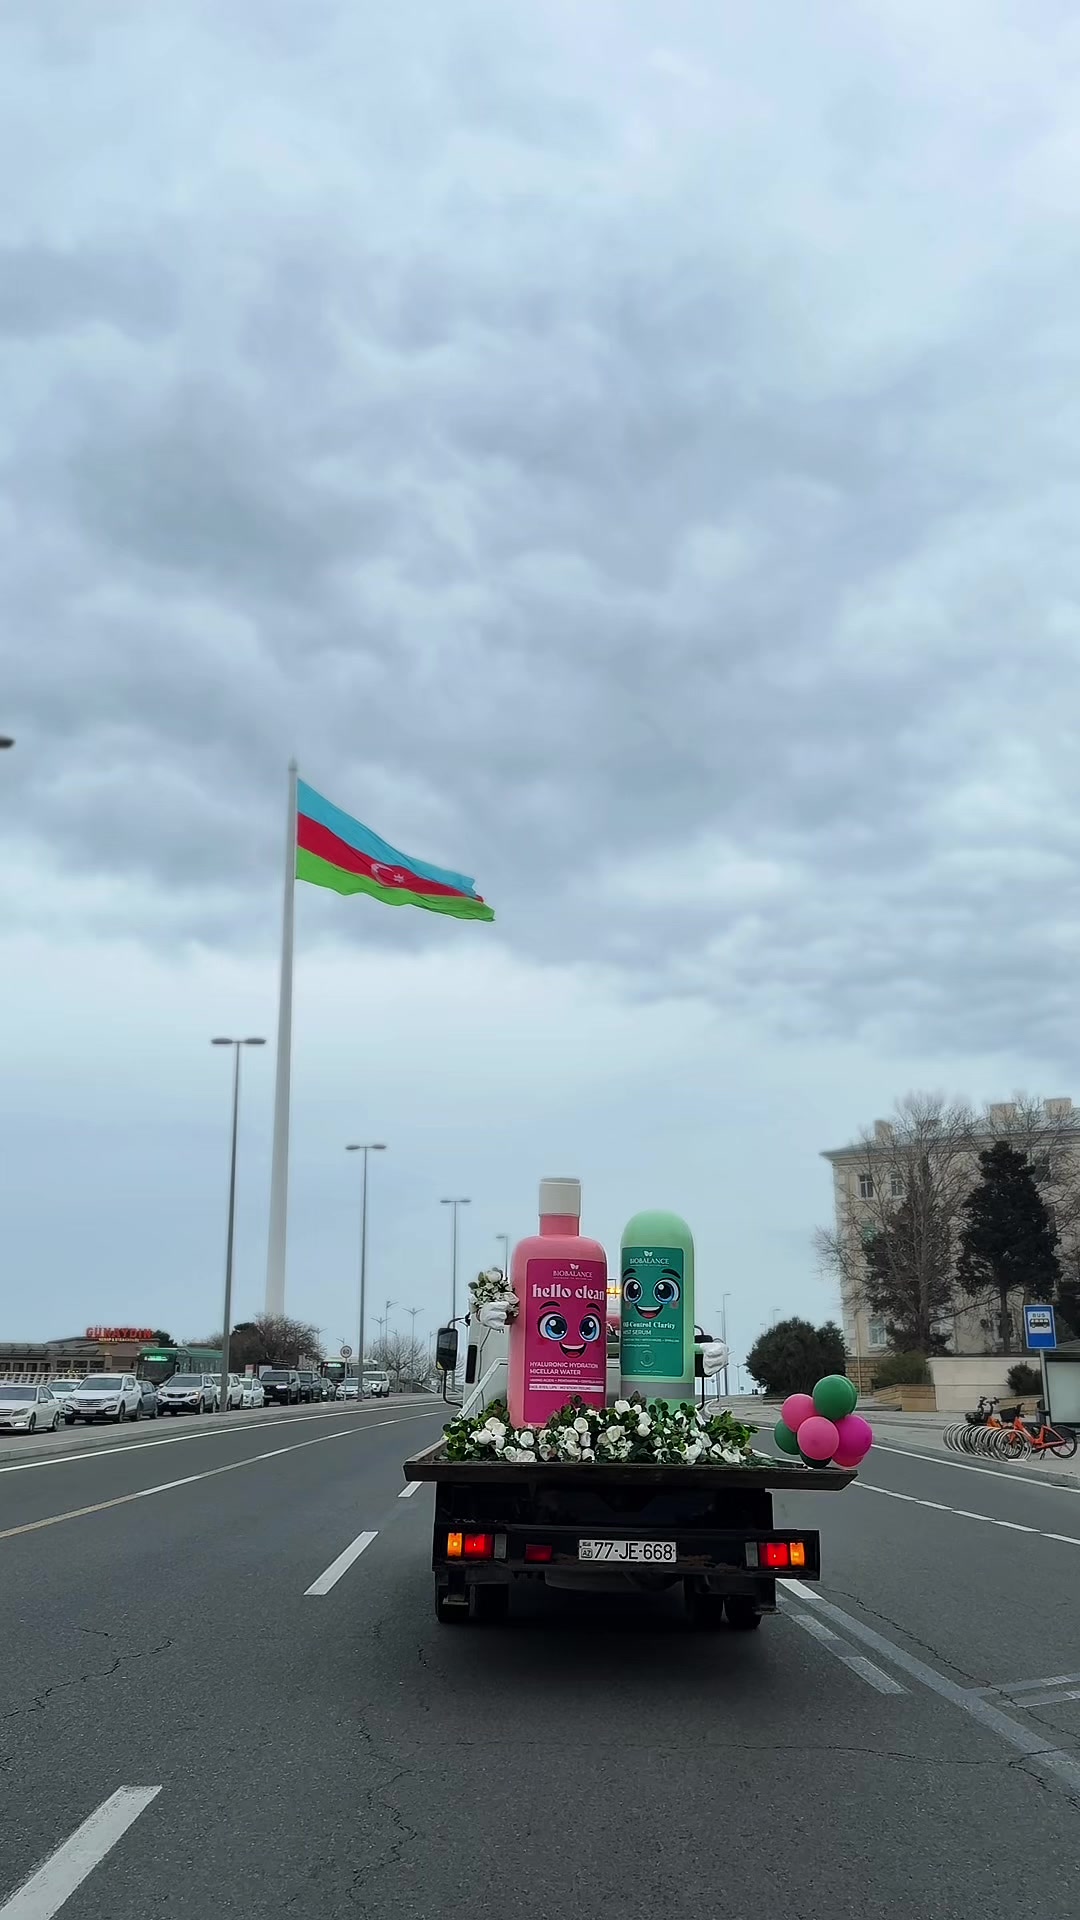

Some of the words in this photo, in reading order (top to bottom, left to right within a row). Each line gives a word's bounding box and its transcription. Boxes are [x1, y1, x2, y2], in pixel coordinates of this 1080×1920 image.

[552, 1270, 593, 1278] BIOBALANCE
[532, 1283, 572, 1298] hello
[574, 1285, 605, 1300] clean
[86, 1325, 152, 1339] GÜNAYDIN
[653, 1321, 676, 1330] Clarity
[594, 1542, 673, 1560] 77-JE-668
